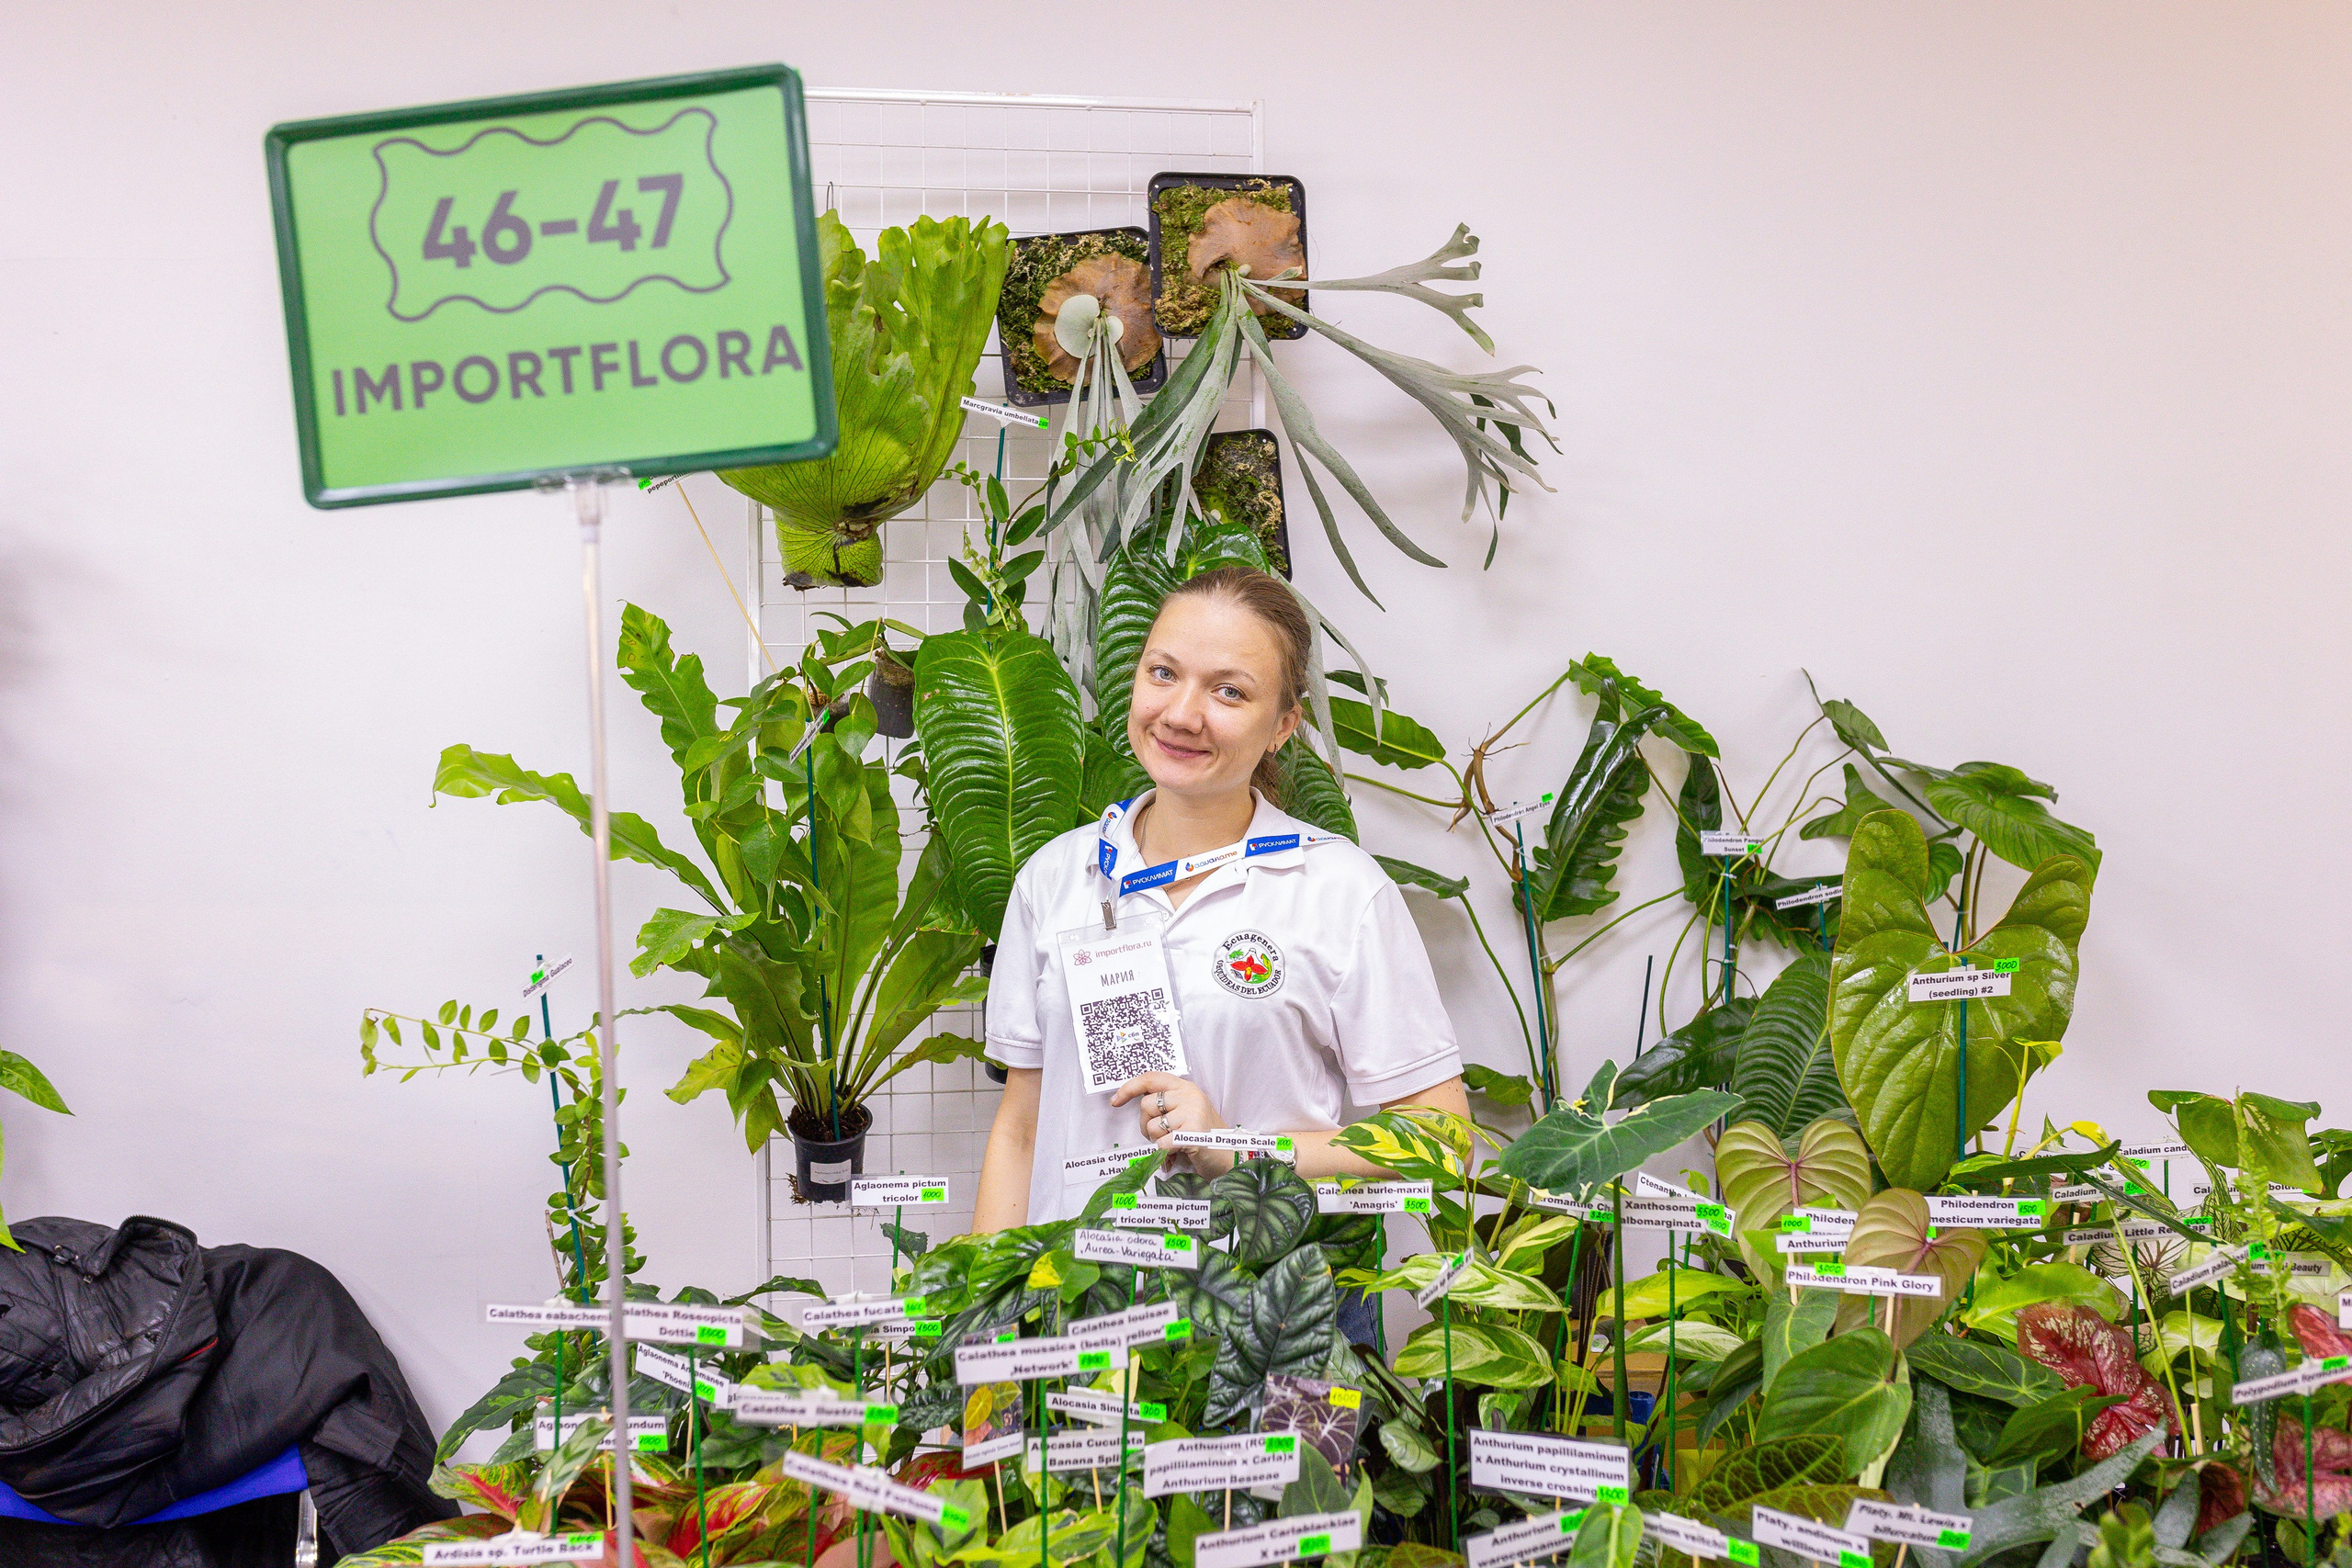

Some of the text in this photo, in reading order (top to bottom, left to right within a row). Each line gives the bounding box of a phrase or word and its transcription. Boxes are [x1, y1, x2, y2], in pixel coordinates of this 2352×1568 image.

[423, 173, 684, 268] 46-47
[333, 325, 804, 416] IMPORTFLORA
[963, 399, 1002, 415] Marcgravia
[1004, 411, 1039, 425] umbellata
[1778, 893, 1824, 908] Philodendron
[1095, 940, 1152, 958] importflora.ru
[1223, 933, 1279, 962] Ecuagenera
[1995, 960, 2018, 971] 3000
[1240, 987, 1257, 995] DEL
[1257, 969, 1282, 995] ECUADOR
[1912, 975, 1964, 986] Anthurium
[1982, 972, 2010, 980] Silver
[1928, 986, 1994, 999] (seedling) #2
[1174, 1134, 1276, 1146] Alocasia Dragon Scale
[1065, 1156, 1106, 1170] Alocasia
[1108, 1146, 1158, 1164] clypeolata
[854, 1179, 946, 1191] Aglaonema pictum
[1367, 1185, 1430, 1195] burle-marxii
[882, 1194, 919, 1202] tricolor
[1114, 1195, 1136, 1206] 1000
[2054, 1189, 2097, 1199] Caladium
[1176, 1203, 1209, 1212] pictum
[1350, 1201, 1398, 1210] 'Amagris'
[1624, 1200, 1695, 1213] Xanthosoma
[1940, 1200, 2014, 1209] Philodendron
[1120, 1215, 1156, 1224] tricolor
[1182, 1217, 1207, 1226] Spot'
[1621, 1217, 1702, 1229] albomarginata
[1805, 1213, 1856, 1225] Philoden
[1929, 1215, 2041, 1227] mesticum variegata
[2124, 1226, 2154, 1236] Little
[1165, 1237, 1187, 1248] 1500
[1787, 1270, 1934, 1292] Philodendron Pink Glory
[2172, 1269, 2210, 1289] Caladium
[490, 1308, 541, 1320] Calathea
[622, 1308, 741, 1325] alathea Roseopicta
[804, 1309, 860, 1321] Calathea
[864, 1305, 904, 1316] fucata
[1071, 1308, 1170, 1334] Calathea louisae
[659, 1326, 695, 1337] Dottie
[958, 1337, 1122, 1361] Calathea musaica (bella)
[638, 1345, 679, 1369] Aglaonema
[741, 1403, 807, 1416] Calathea
[1052, 1397, 1140, 1416] Alocasia Sinuta
[1031, 1438, 1082, 1451] Aocasia
[1086, 1437, 1143, 1449] Cuculata
[1177, 1439, 1241, 1453] Anthurium
[1473, 1436, 1625, 1464] Anthurium papillilaminum
[1049, 1454, 1122, 1467] Banana Spli
[1149, 1459, 1238, 1476] papillilaminum
[1475, 1456, 1624, 1482] x Anthurium crystallinum
[1162, 1475, 1227, 1489] Anthurium
[1500, 1474, 1597, 1498] inverse crossing
[1199, 1532, 1266, 1551] Anthurium
[1491, 1523, 1555, 1547] Anthurium
[435, 1543, 594, 1561] Ardisia sp. Turtle Back
[1273, 1544, 1296, 1557] self
